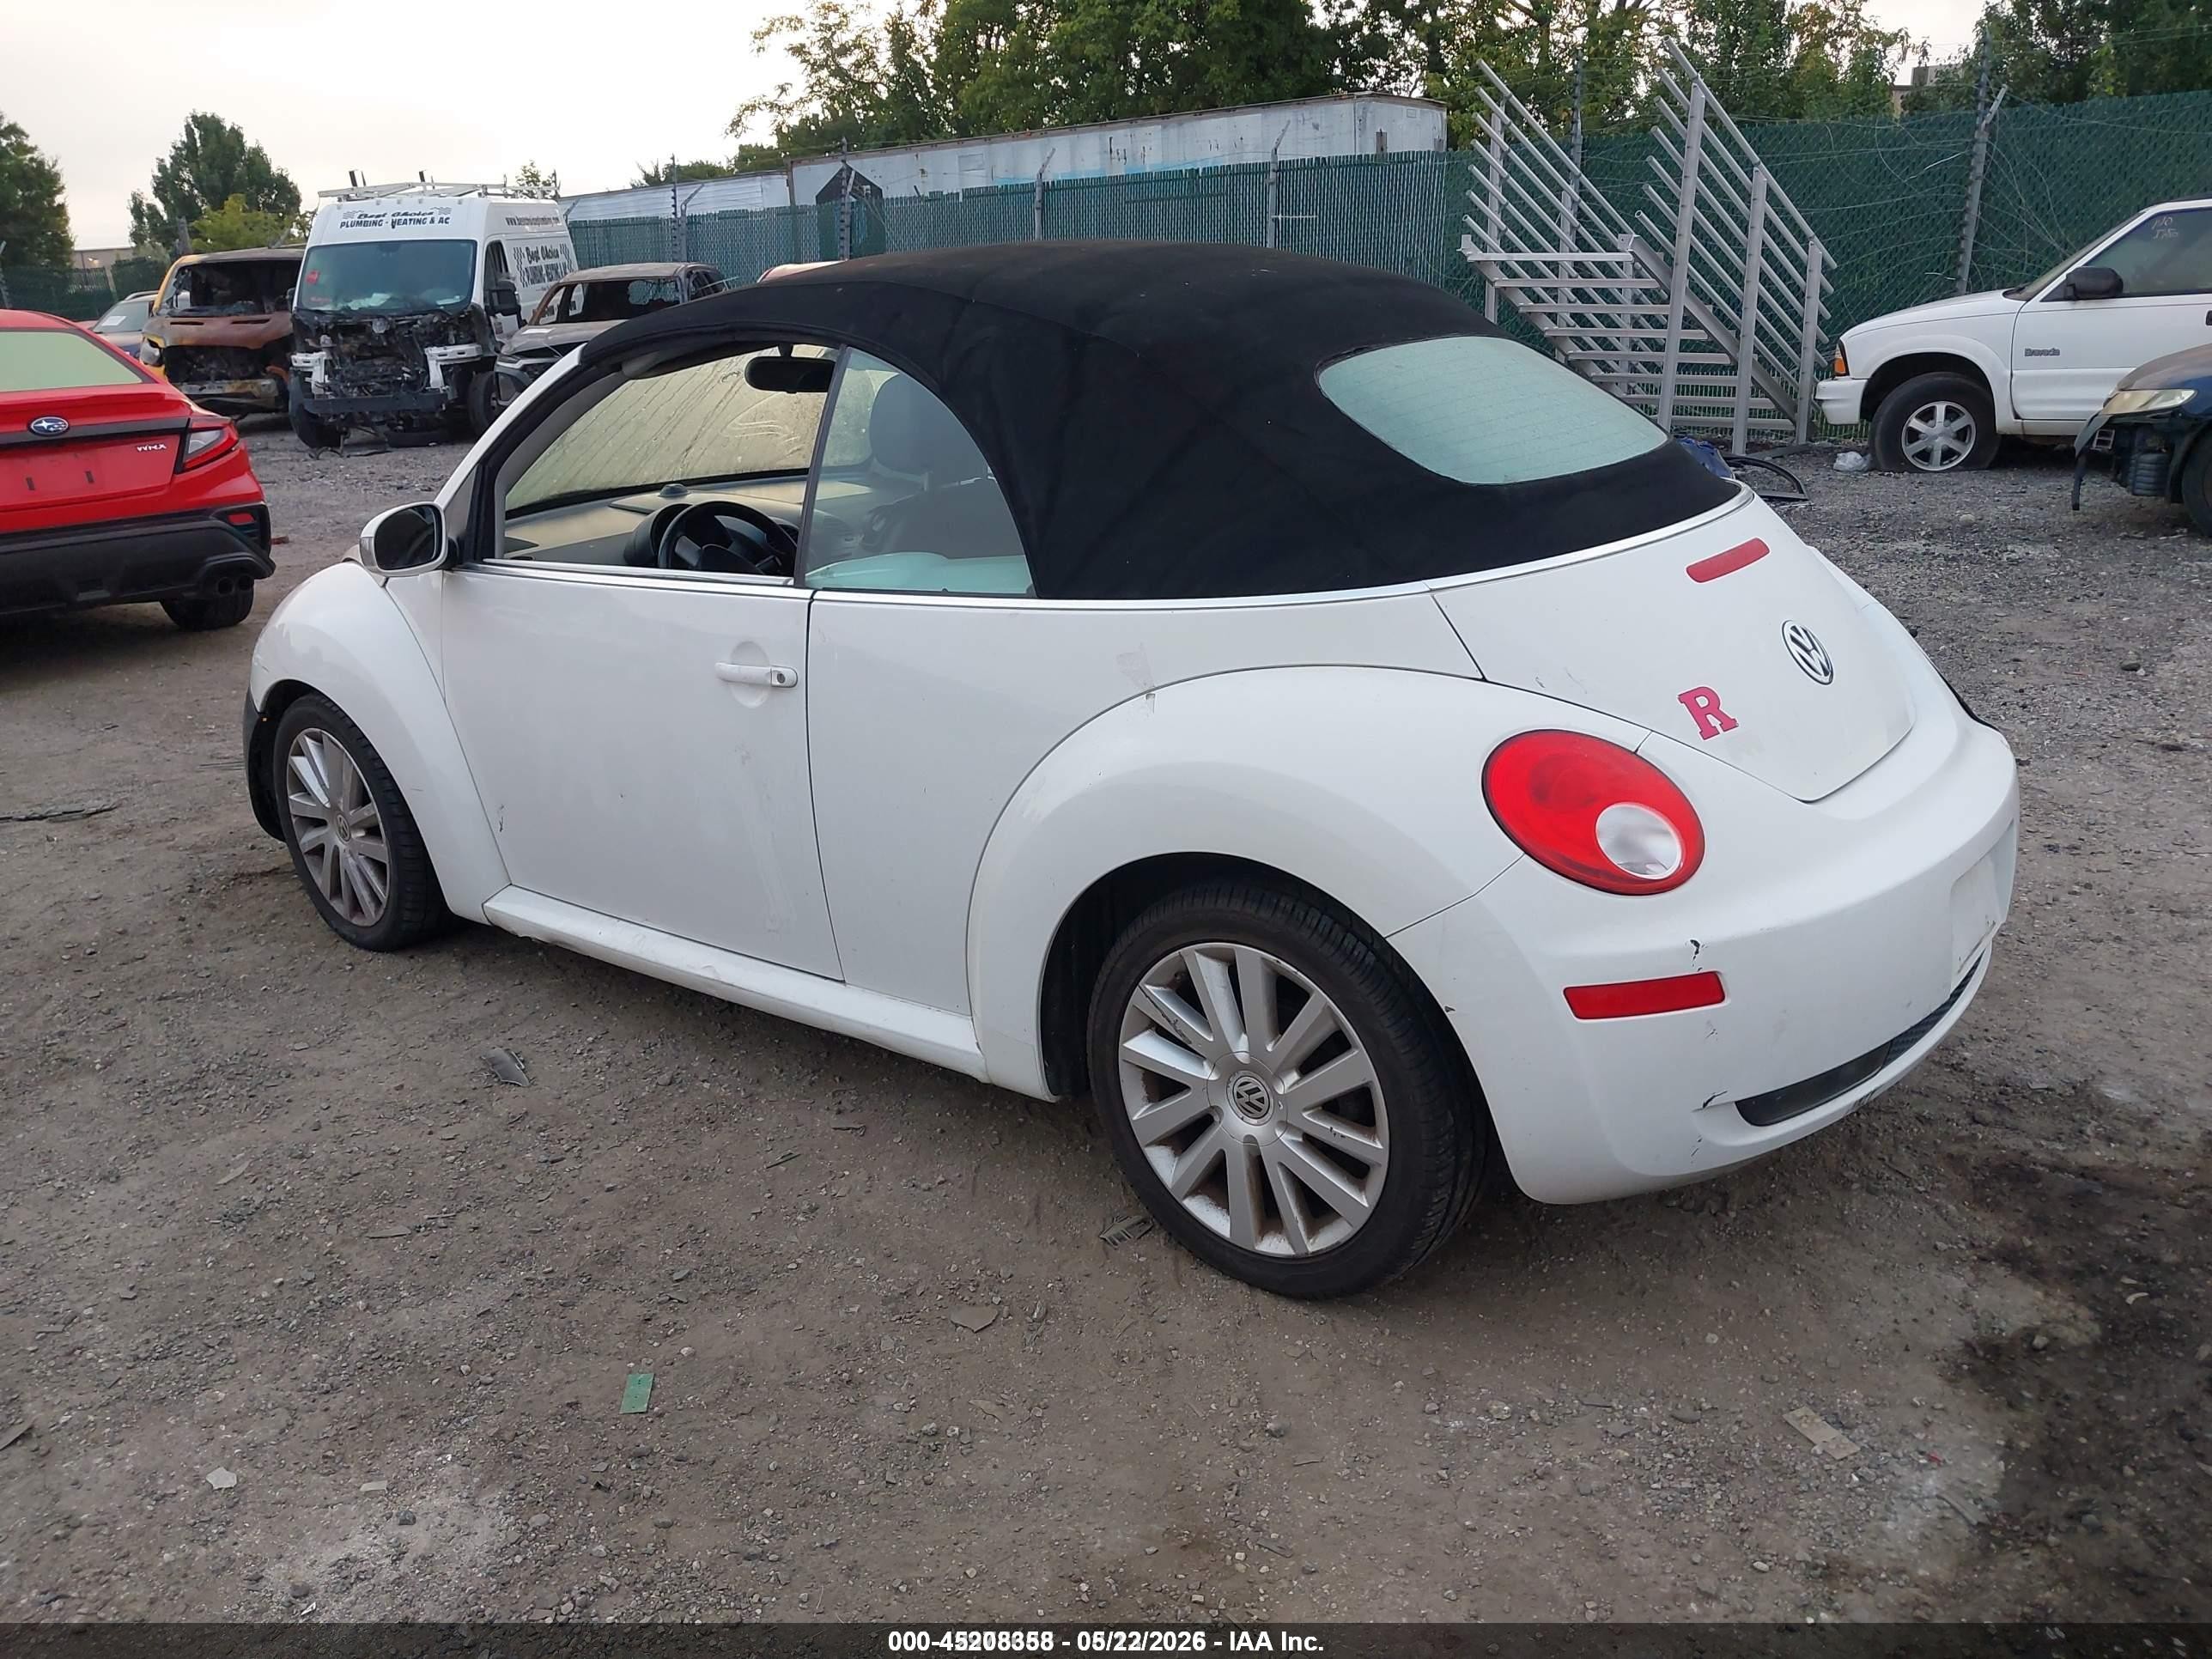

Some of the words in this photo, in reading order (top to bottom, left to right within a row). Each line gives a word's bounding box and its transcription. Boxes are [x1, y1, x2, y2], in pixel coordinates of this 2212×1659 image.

[339, 219, 384, 229] PLUMBING
[437, 216, 451, 225] AC
[137, 443, 167, 453] WRX
[1677, 686, 1739, 740] R
